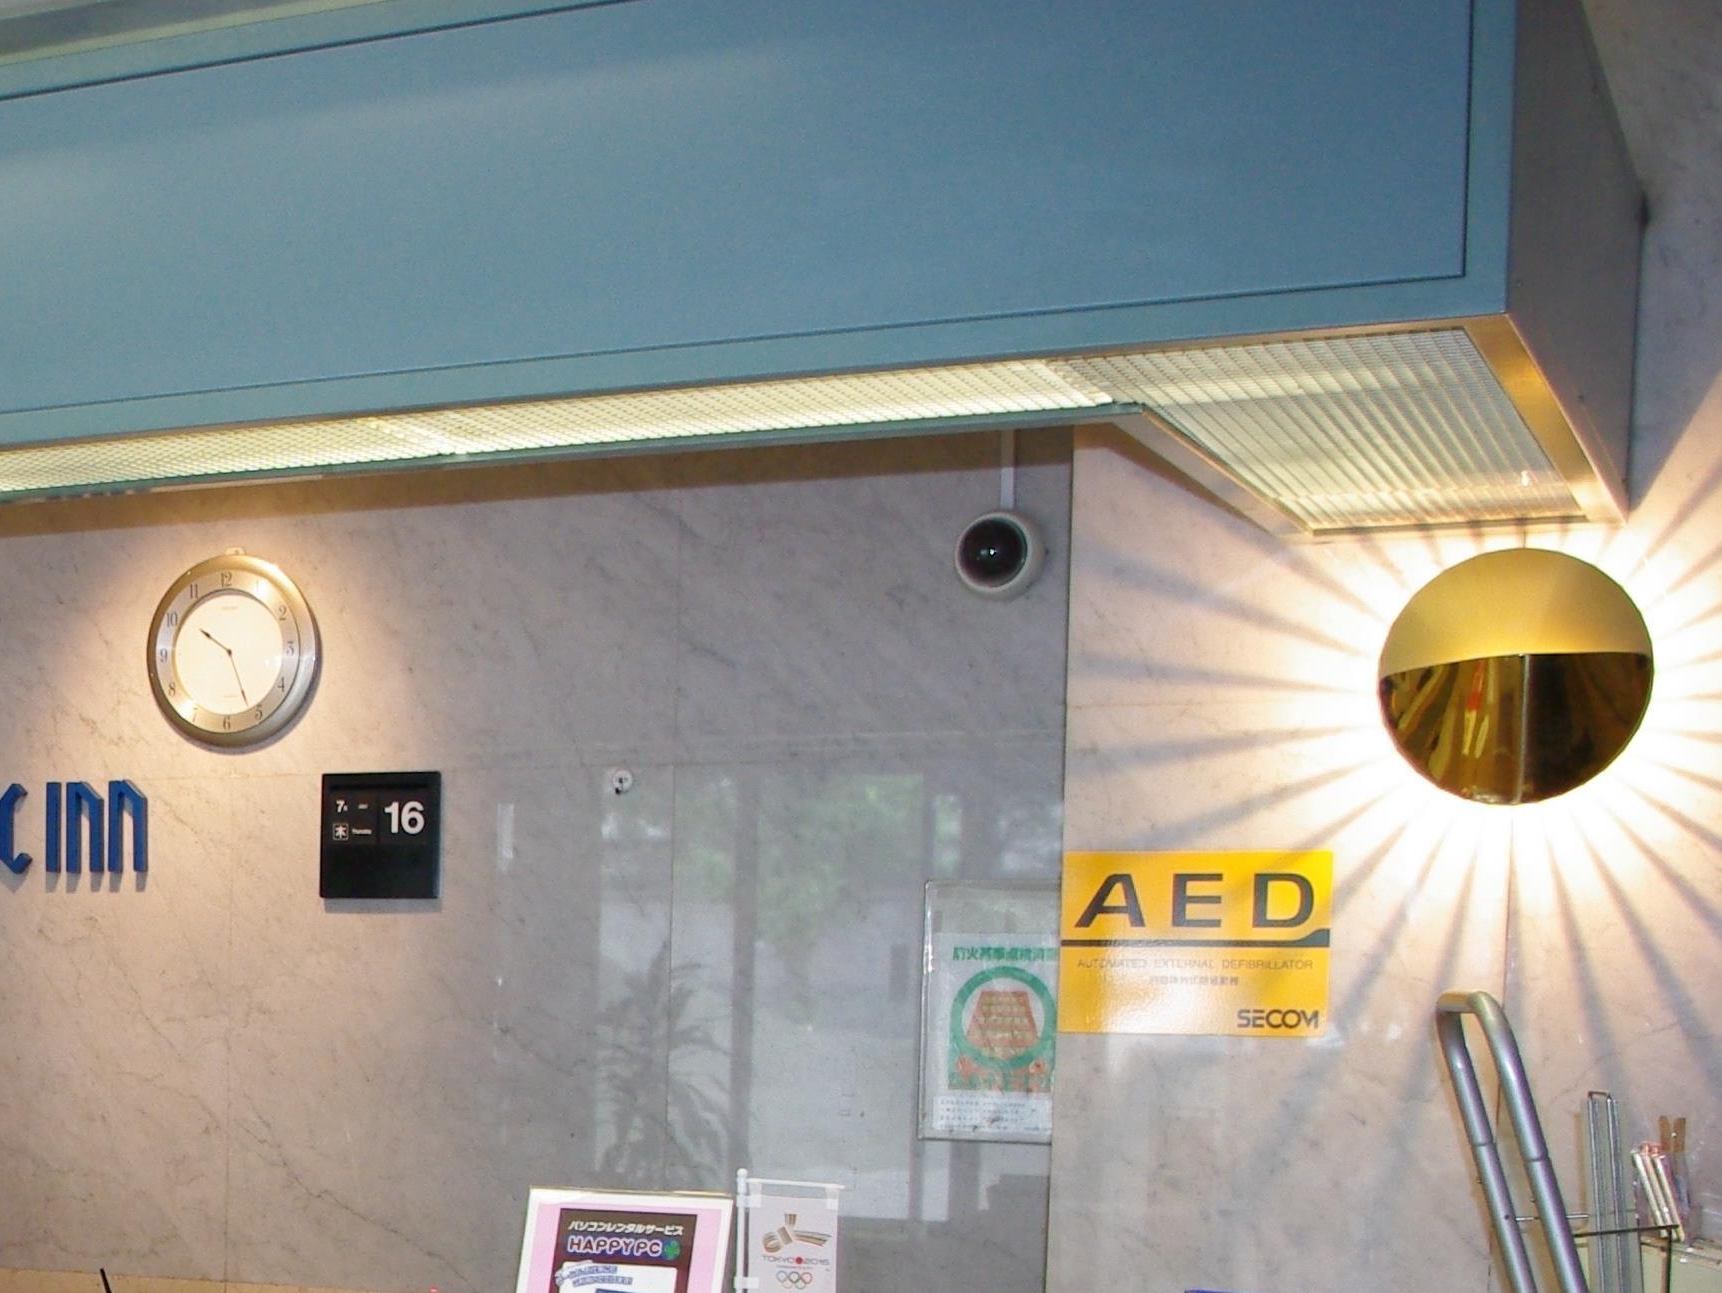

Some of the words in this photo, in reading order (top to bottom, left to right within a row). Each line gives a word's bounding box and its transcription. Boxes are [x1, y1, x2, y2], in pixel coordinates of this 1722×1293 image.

[220, 571, 233, 588] 12
[189, 583, 199, 600] 11
[166, 611, 178, 628] 10
[278, 604, 287, 622] 2
[159, 647, 168, 664] 9
[285, 640, 295, 656] 3
[167, 682, 176, 698] 8
[277, 676, 286, 693] 4
[254, 703, 264, 720] 5
[223, 714, 231, 731] 6
[46, 779, 149, 874] INN
[384, 801, 425, 835] 16
[1074, 872, 1315, 929] AED
[1077, 958, 1147, 970] AUTOMATED
[1154, 959, 1215, 970] EXTERNAL
[1221, 959, 1314, 971] DEFIBRILLATOR
[1236, 1009, 1319, 1030] SECOM
[568, 1220, 684, 1236] パソコンレンタルサービス
